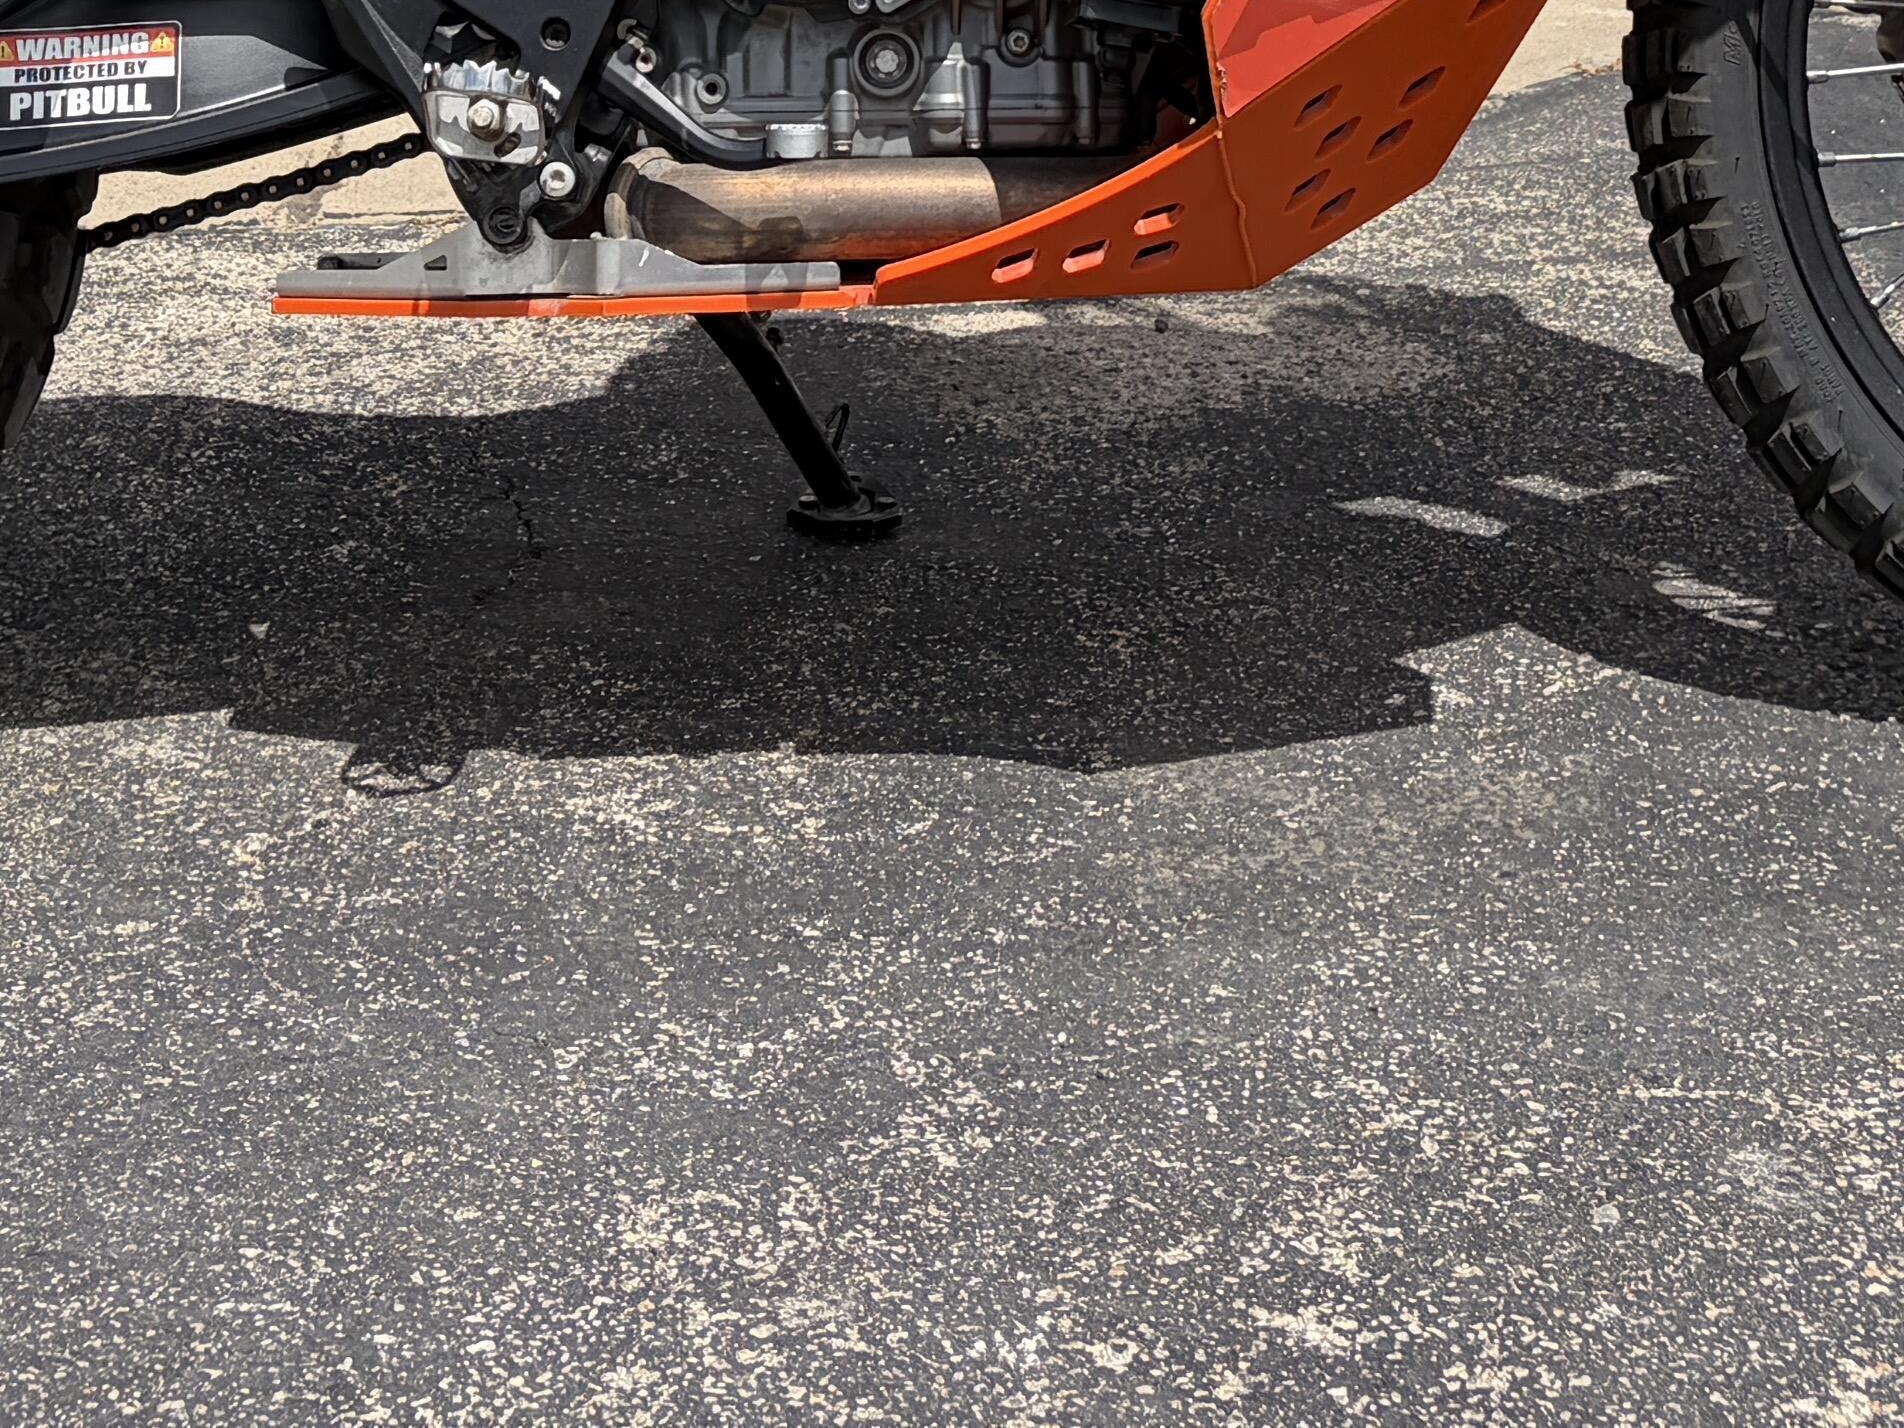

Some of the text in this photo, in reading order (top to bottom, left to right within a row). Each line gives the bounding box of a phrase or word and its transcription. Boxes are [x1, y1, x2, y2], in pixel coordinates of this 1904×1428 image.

[16, 31, 150, 62] WARNING
[14, 59, 147, 83] PROTECTED BY
[9, 82, 152, 121] PITBULL
